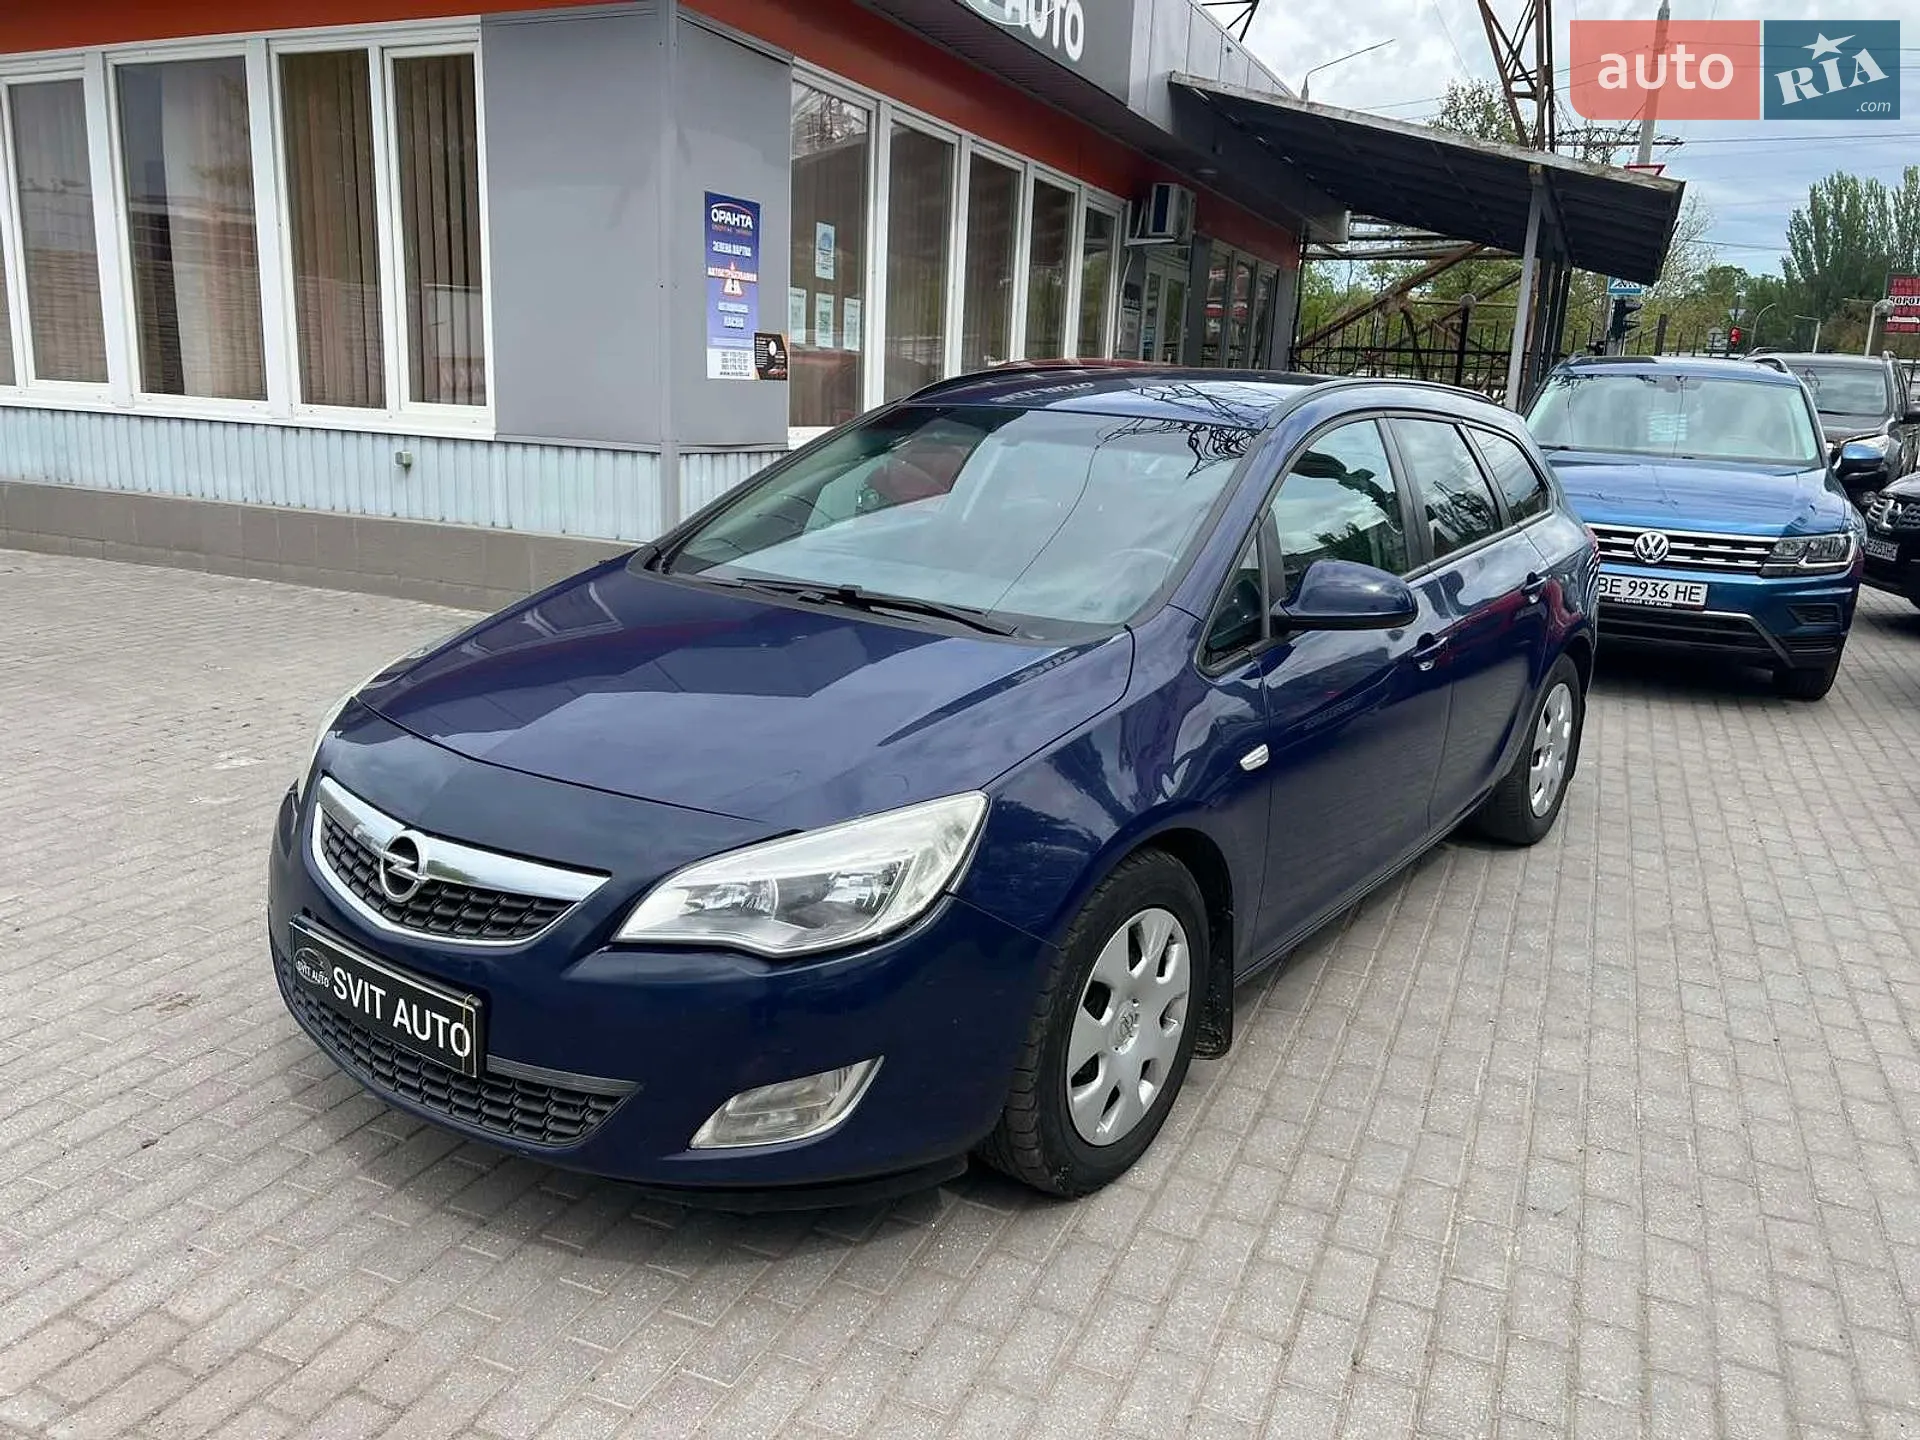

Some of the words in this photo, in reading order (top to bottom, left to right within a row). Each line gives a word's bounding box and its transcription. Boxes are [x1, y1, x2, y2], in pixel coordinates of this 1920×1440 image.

[711, 208, 753, 230] ОРАНТА
[1628, 580, 1669, 599] 9936
[1674, 584, 1702, 603] HE
[332, 966, 387, 1020] SVIT
[392, 998, 471, 1058] AUTO
